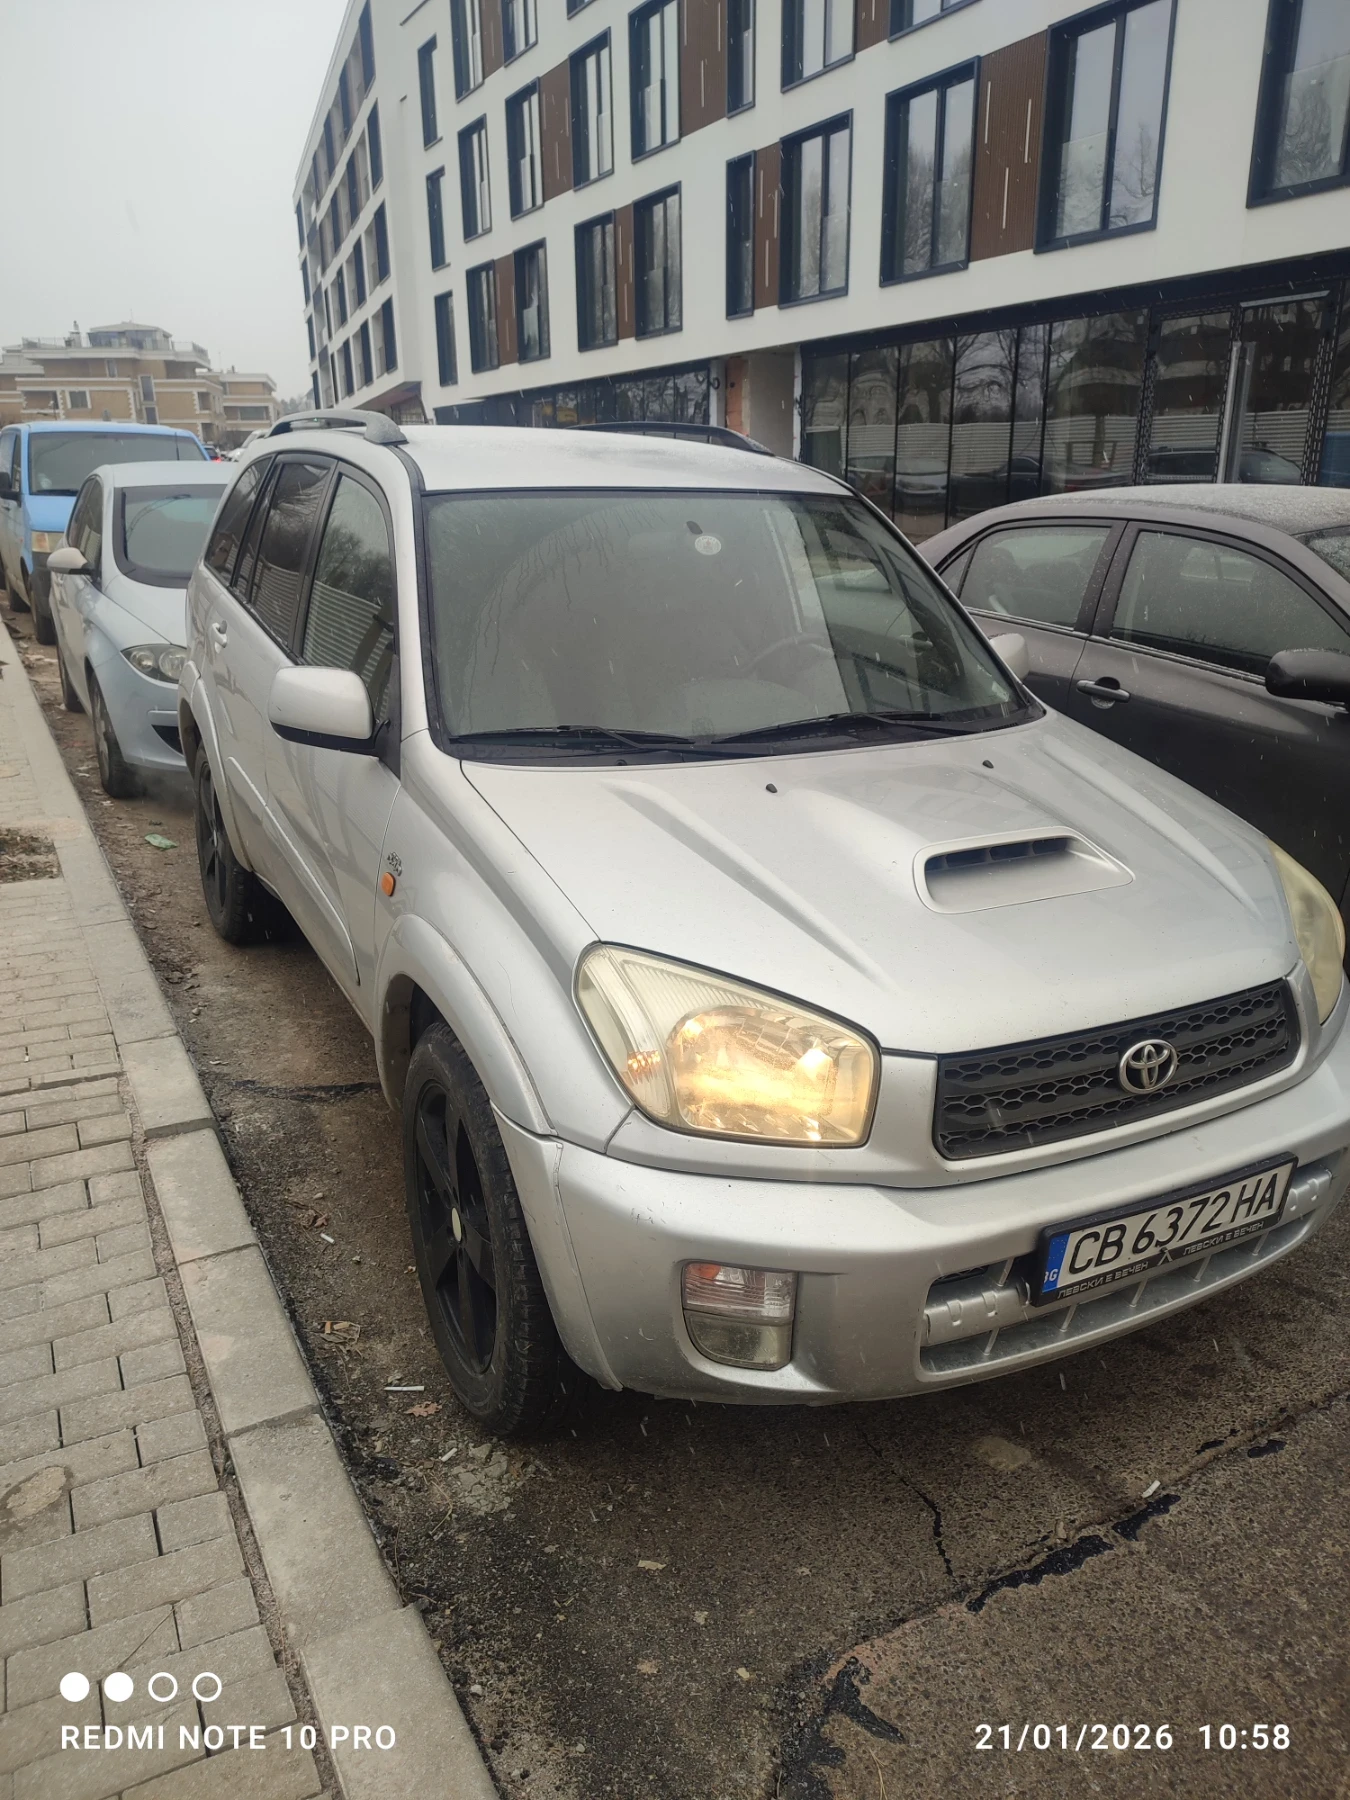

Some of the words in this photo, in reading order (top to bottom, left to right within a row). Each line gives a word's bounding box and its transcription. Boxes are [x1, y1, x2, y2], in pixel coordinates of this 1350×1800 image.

[1068, 1224, 1127, 1275] CB
[1132, 1191, 1231, 1254] 6372
[1230, 1172, 1278, 1223] HA
[1182, 1236, 1224, 1256] ЛЕВСКИ
[1225, 1231, 1233, 1241] Е
[1233, 1221, 1265, 1238] ВЕЧЕН
[1057, 1277, 1104, 1299] ЛЕВСКИ
[1105, 1273, 1113, 1283] Е
[1115, 1261, 1149, 1280] ВЕЧЕН
